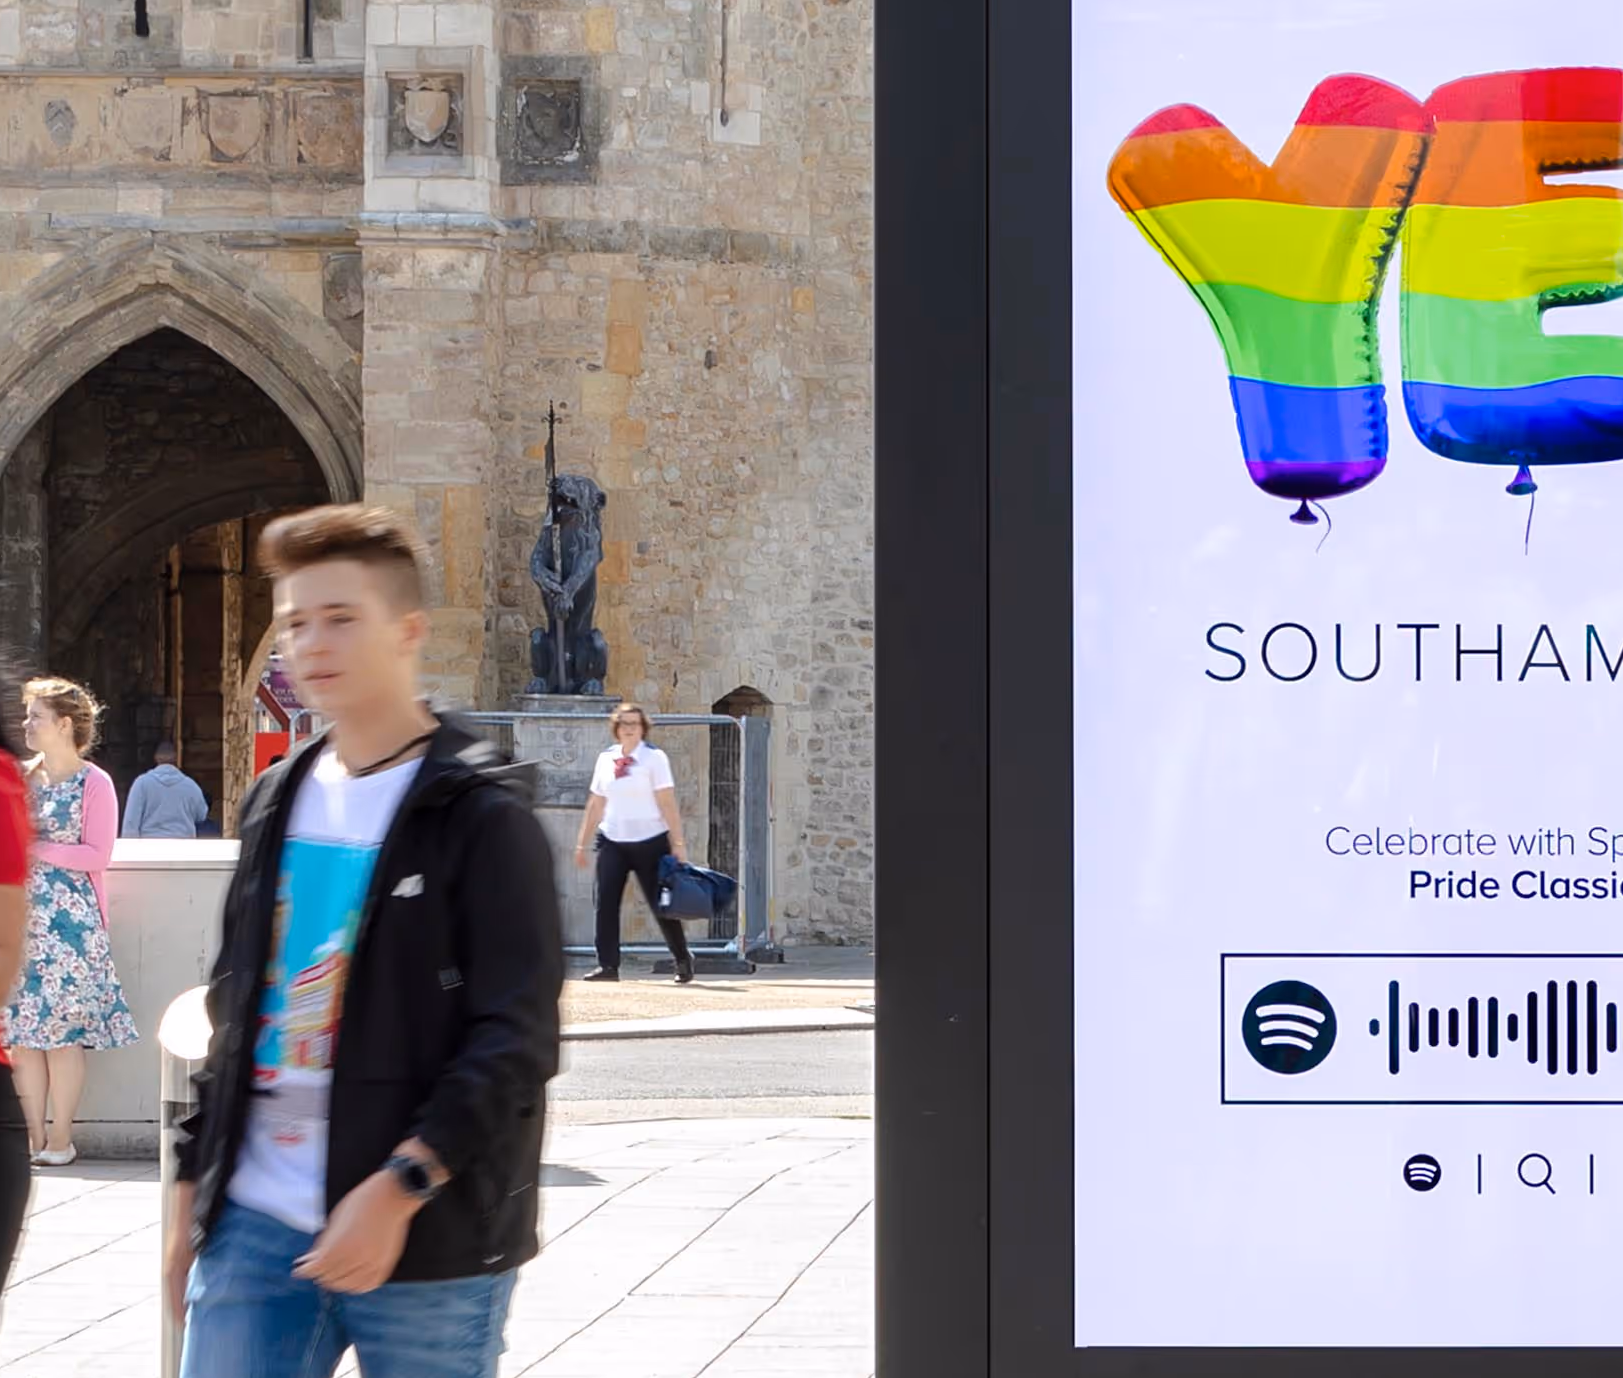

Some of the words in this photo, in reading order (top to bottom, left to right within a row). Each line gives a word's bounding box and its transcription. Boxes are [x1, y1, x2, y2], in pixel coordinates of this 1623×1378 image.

[1325, 826, 1497, 857] Celebrate
[1508, 825, 1575, 856] with
[1410, 871, 1500, 900] Pride
